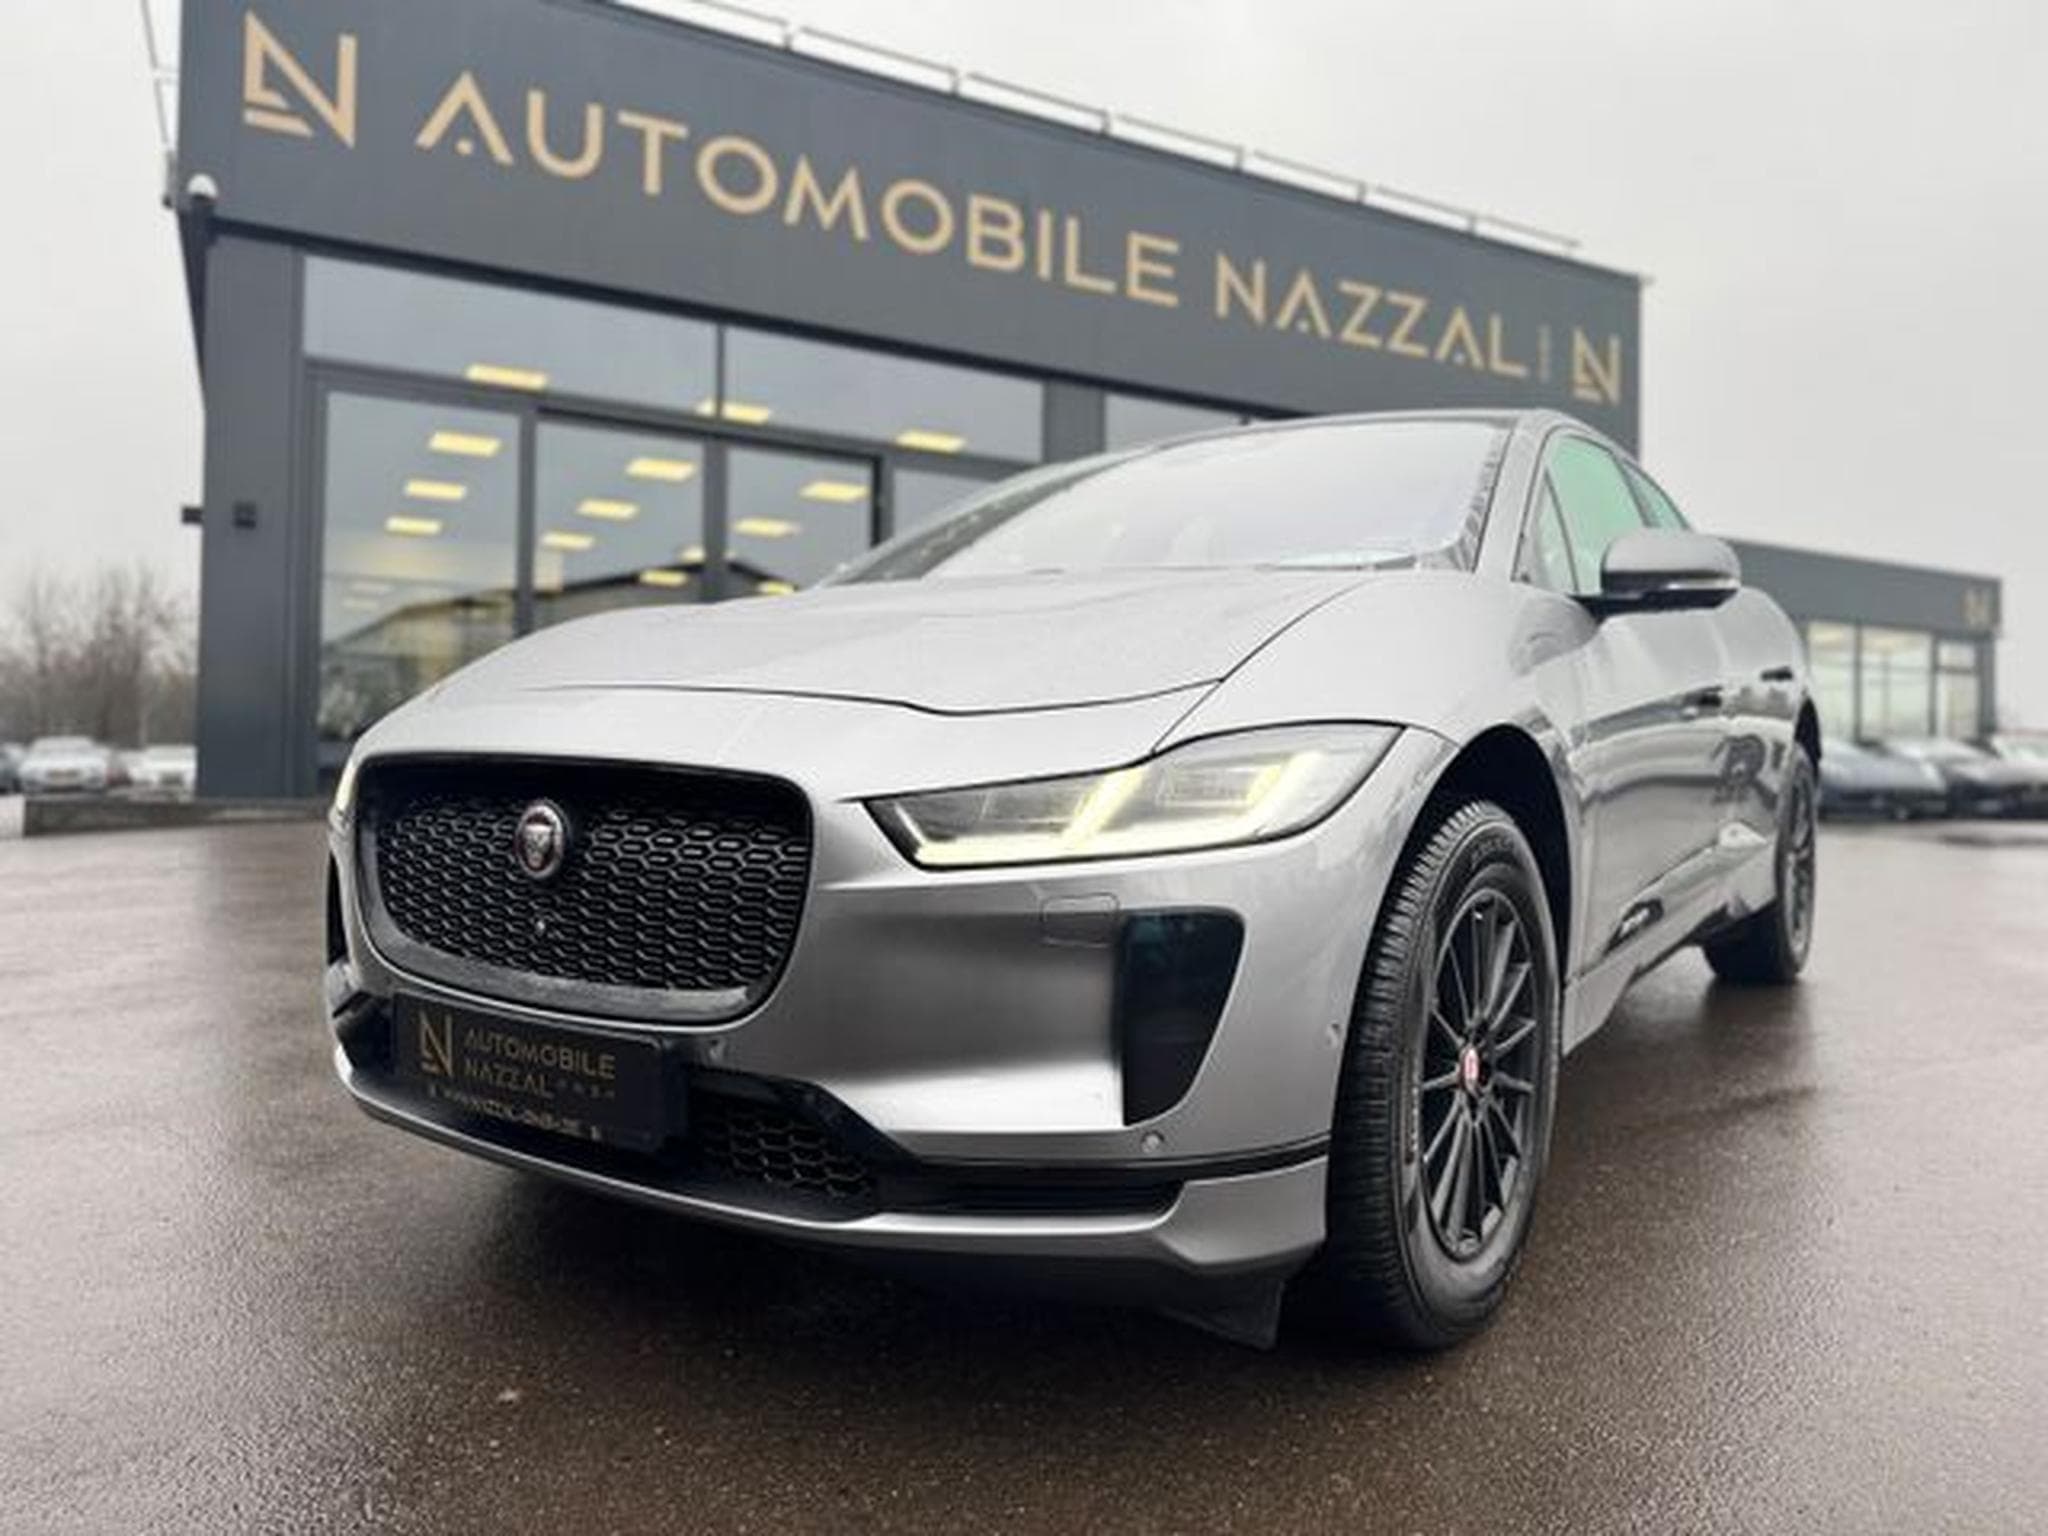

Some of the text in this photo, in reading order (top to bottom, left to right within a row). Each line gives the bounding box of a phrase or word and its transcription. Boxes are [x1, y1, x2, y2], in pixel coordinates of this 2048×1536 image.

[415, 70, 1180, 306] AUTOMOBILE
[1216, 252, 1528, 378] NAZZAL
[463, 1027, 617, 1081] AUTOMOBILE
[463, 1058, 556, 1101] NAZZAL
